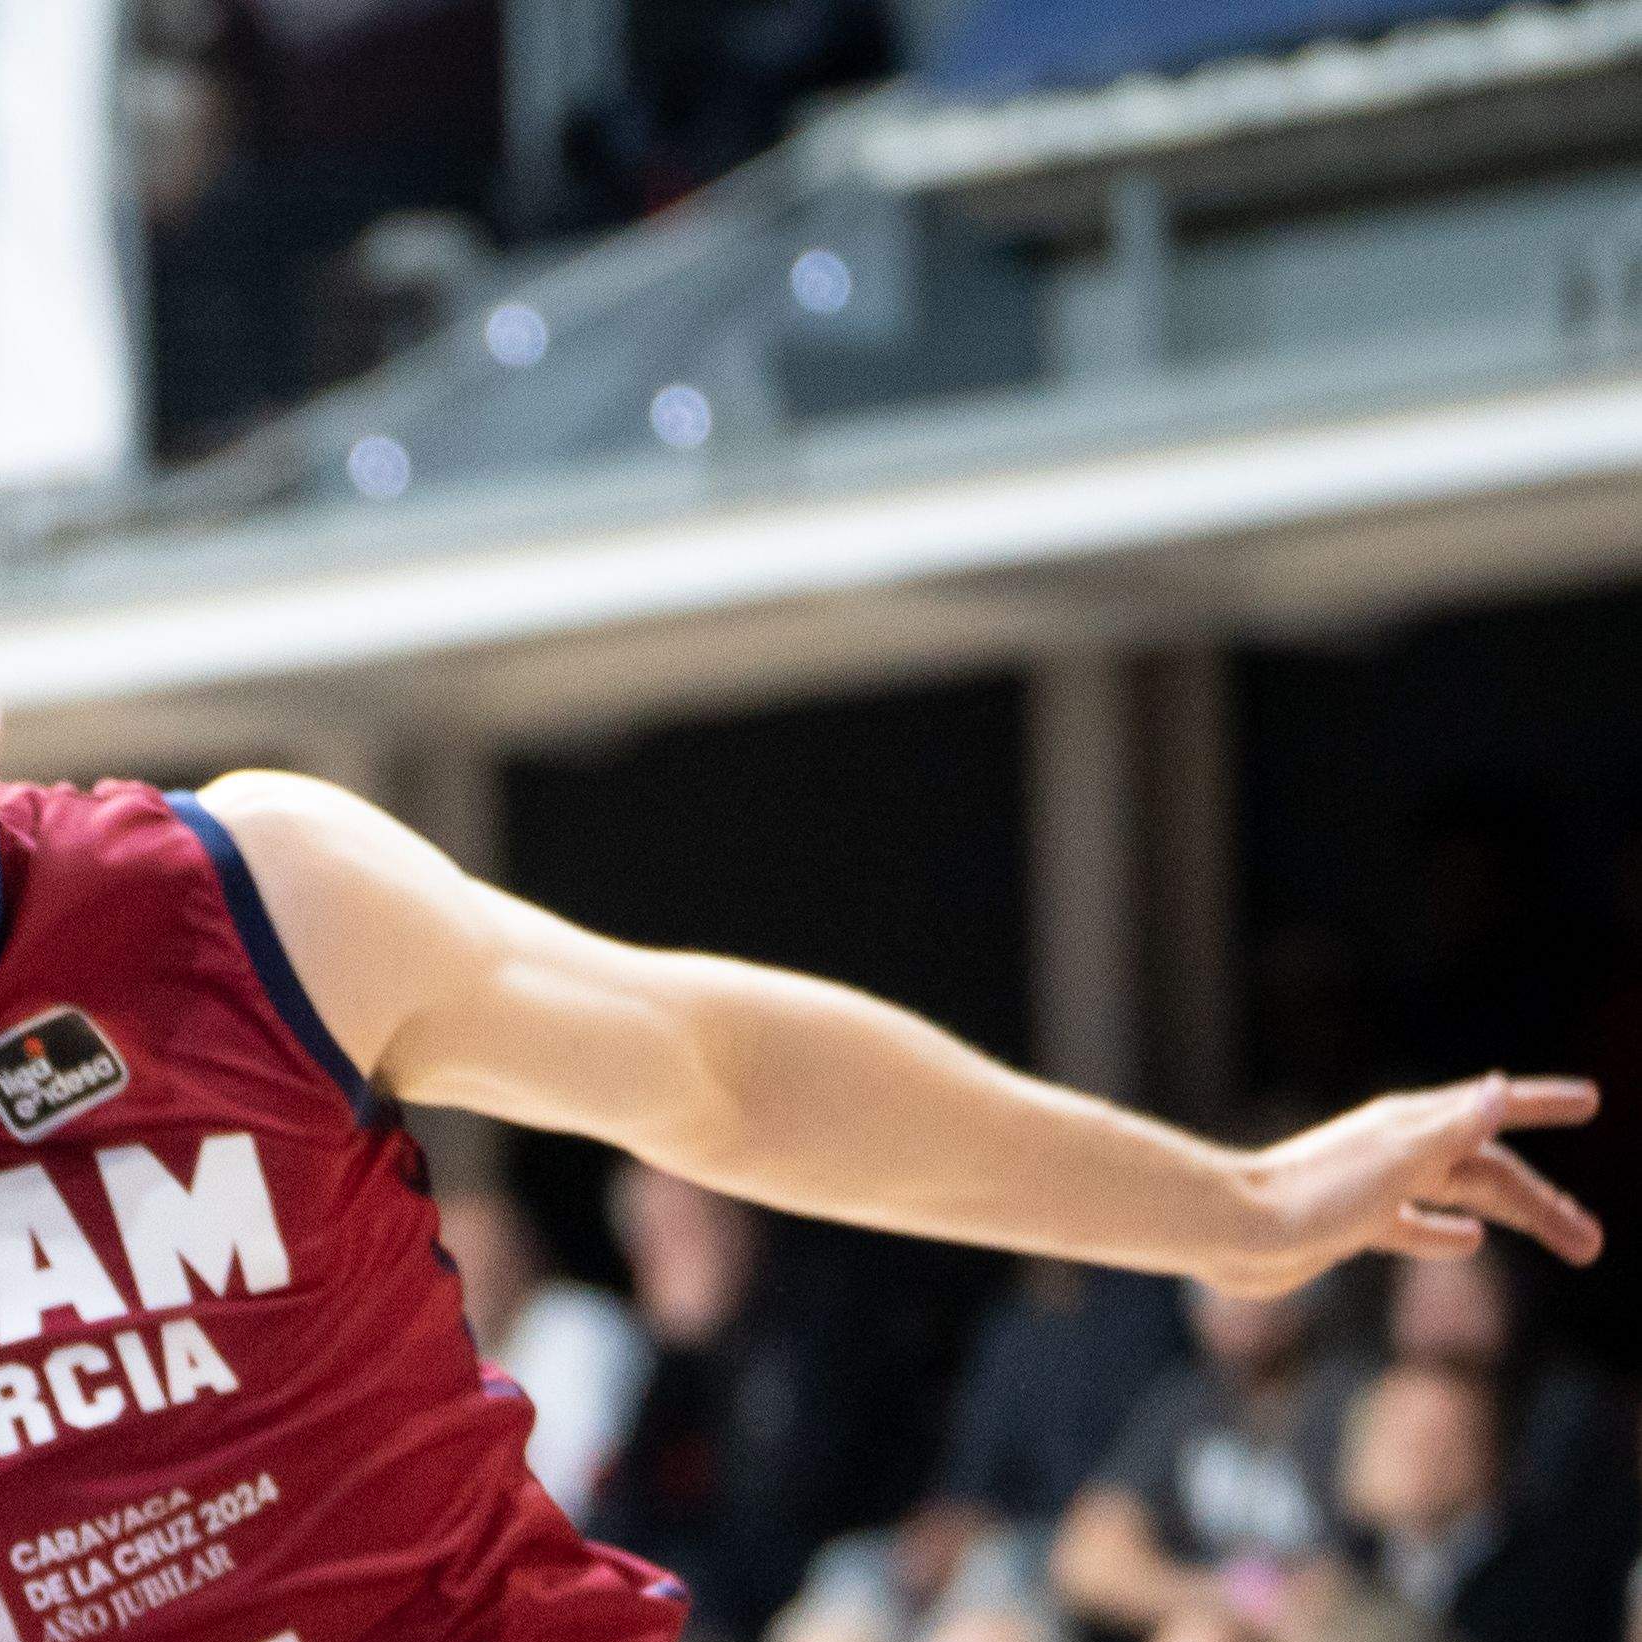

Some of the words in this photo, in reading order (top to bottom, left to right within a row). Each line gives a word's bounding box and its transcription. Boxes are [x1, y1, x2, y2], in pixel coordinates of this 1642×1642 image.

[9, 1488, 193, 1574] CARAVACA
[23, 1573, 70, 1613] DE
[69, 1557, 115, 1598] LA
[113, 1512, 202, 1576] CRUZ
[198, 1475, 281, 1536] 2024
